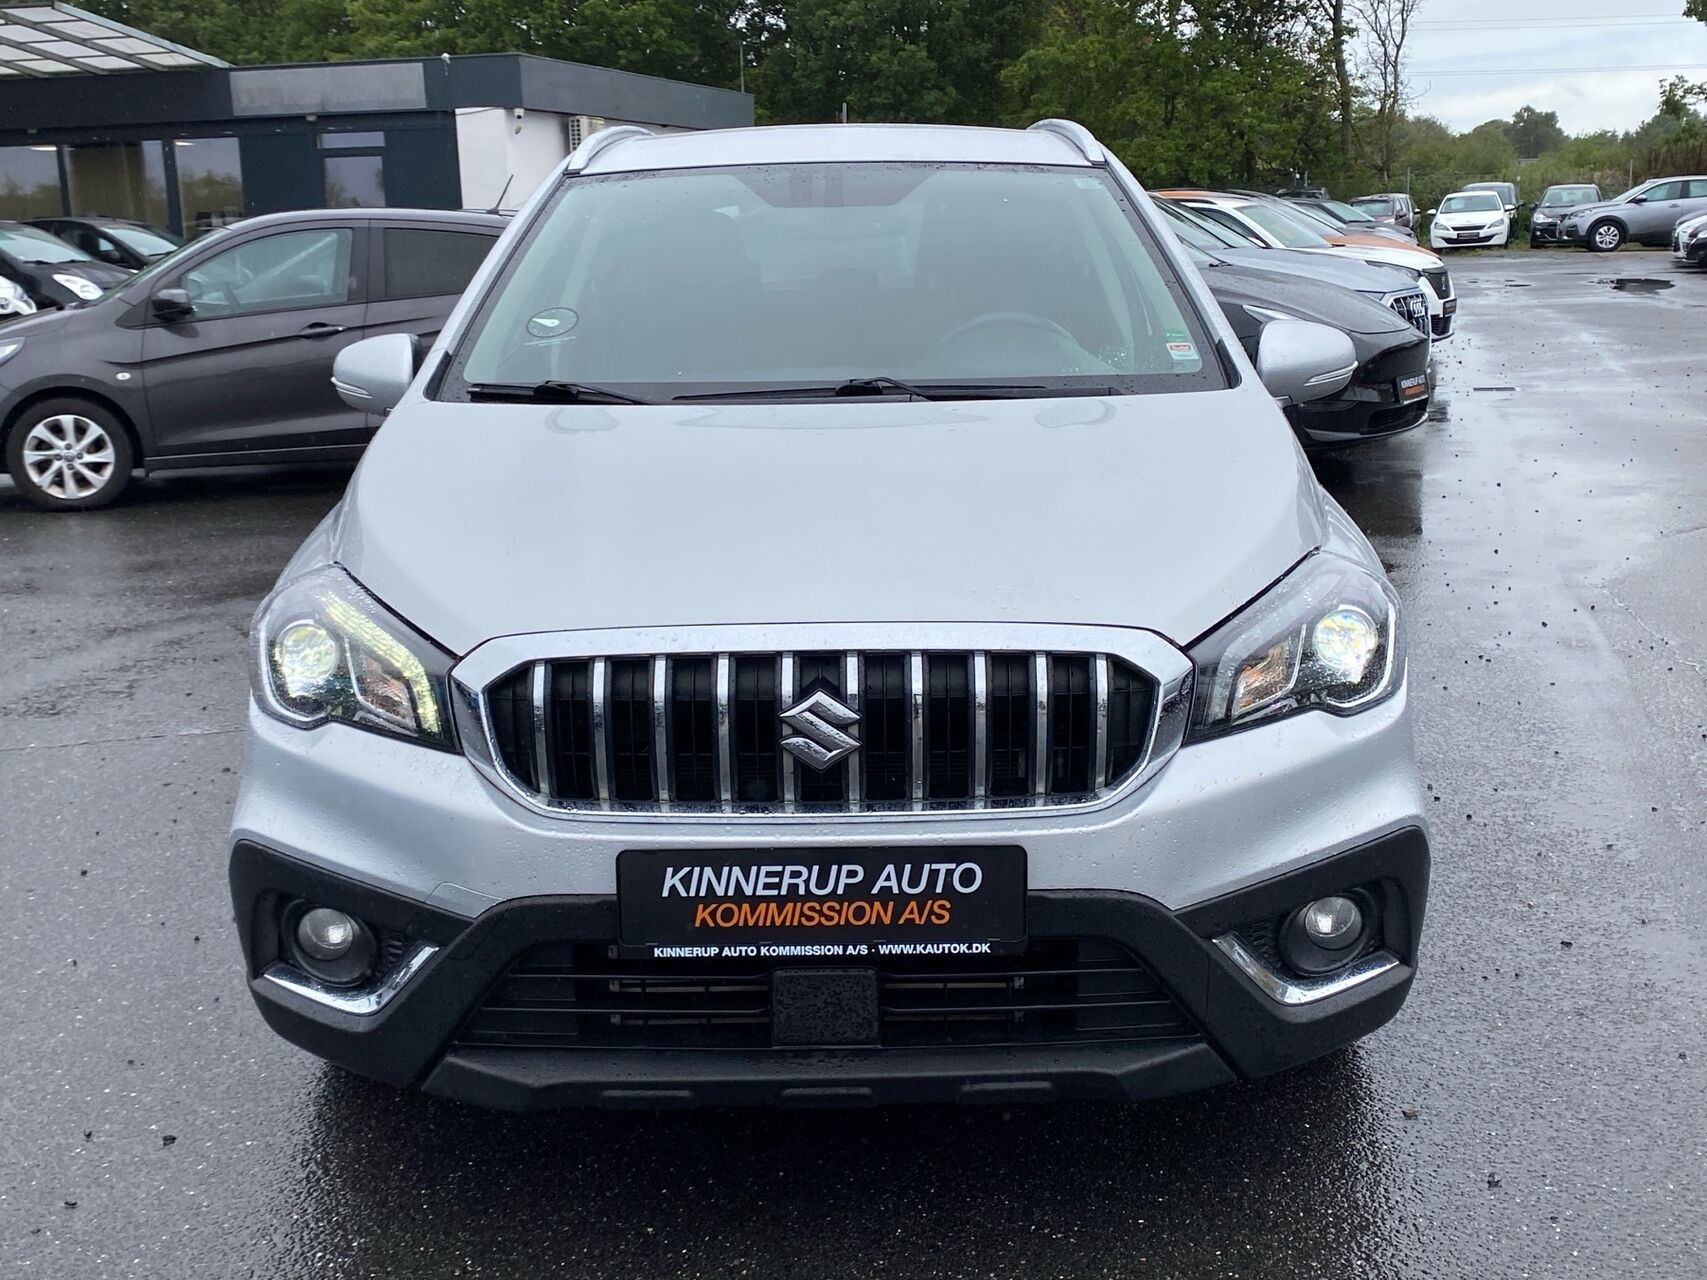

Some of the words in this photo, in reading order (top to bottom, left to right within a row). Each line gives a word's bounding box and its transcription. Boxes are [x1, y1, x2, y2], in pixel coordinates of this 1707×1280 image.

[661, 864, 865, 898] KINNERUP
[870, 862, 983, 895] AUTO
[694, 901, 894, 928] KOMMISSION
[898, 899, 952, 925] A/S
[653, 946, 719, 958] KINNERUP
[721, 946, 758, 957] AUTO
[760, 945, 843, 957] KOMMISSION
[845, 944, 869, 955] A/S
[878, 942, 992, 955] WWW.KAUTOK.DK
